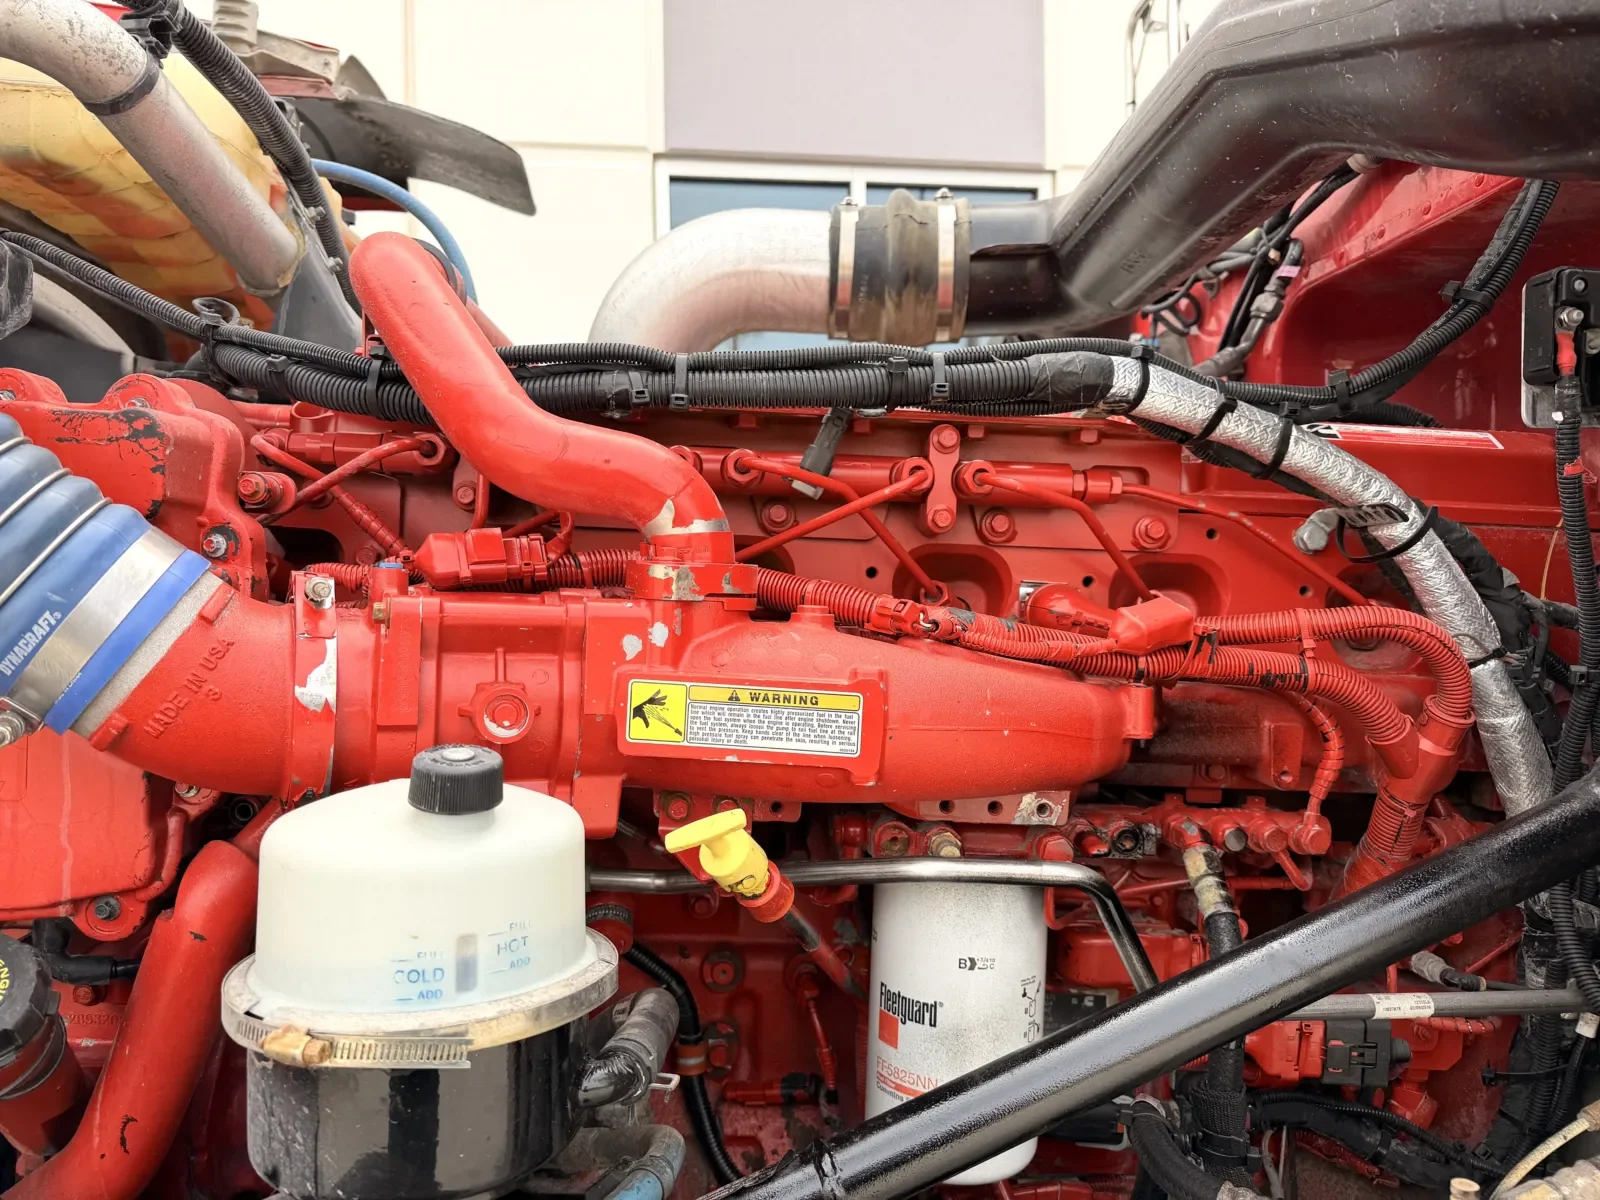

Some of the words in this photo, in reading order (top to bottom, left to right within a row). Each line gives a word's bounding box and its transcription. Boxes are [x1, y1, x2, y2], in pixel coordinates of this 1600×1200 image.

[144, 692, 191, 739] MADE
[184, 671, 207, 694] IN
[201, 637, 235, 671] USA
[749, 692, 819, 706] WARNING
[497, 936, 528, 955] HOT
[510, 957, 530, 969] ADD
[958, 958, 967, 969] B
[393, 967, 444, 984] COLD
[417, 989, 443, 1000] ADD
[880, 981, 938, 1028] Fleetguard
[876, 1055, 939, 1090] FF5825NN
